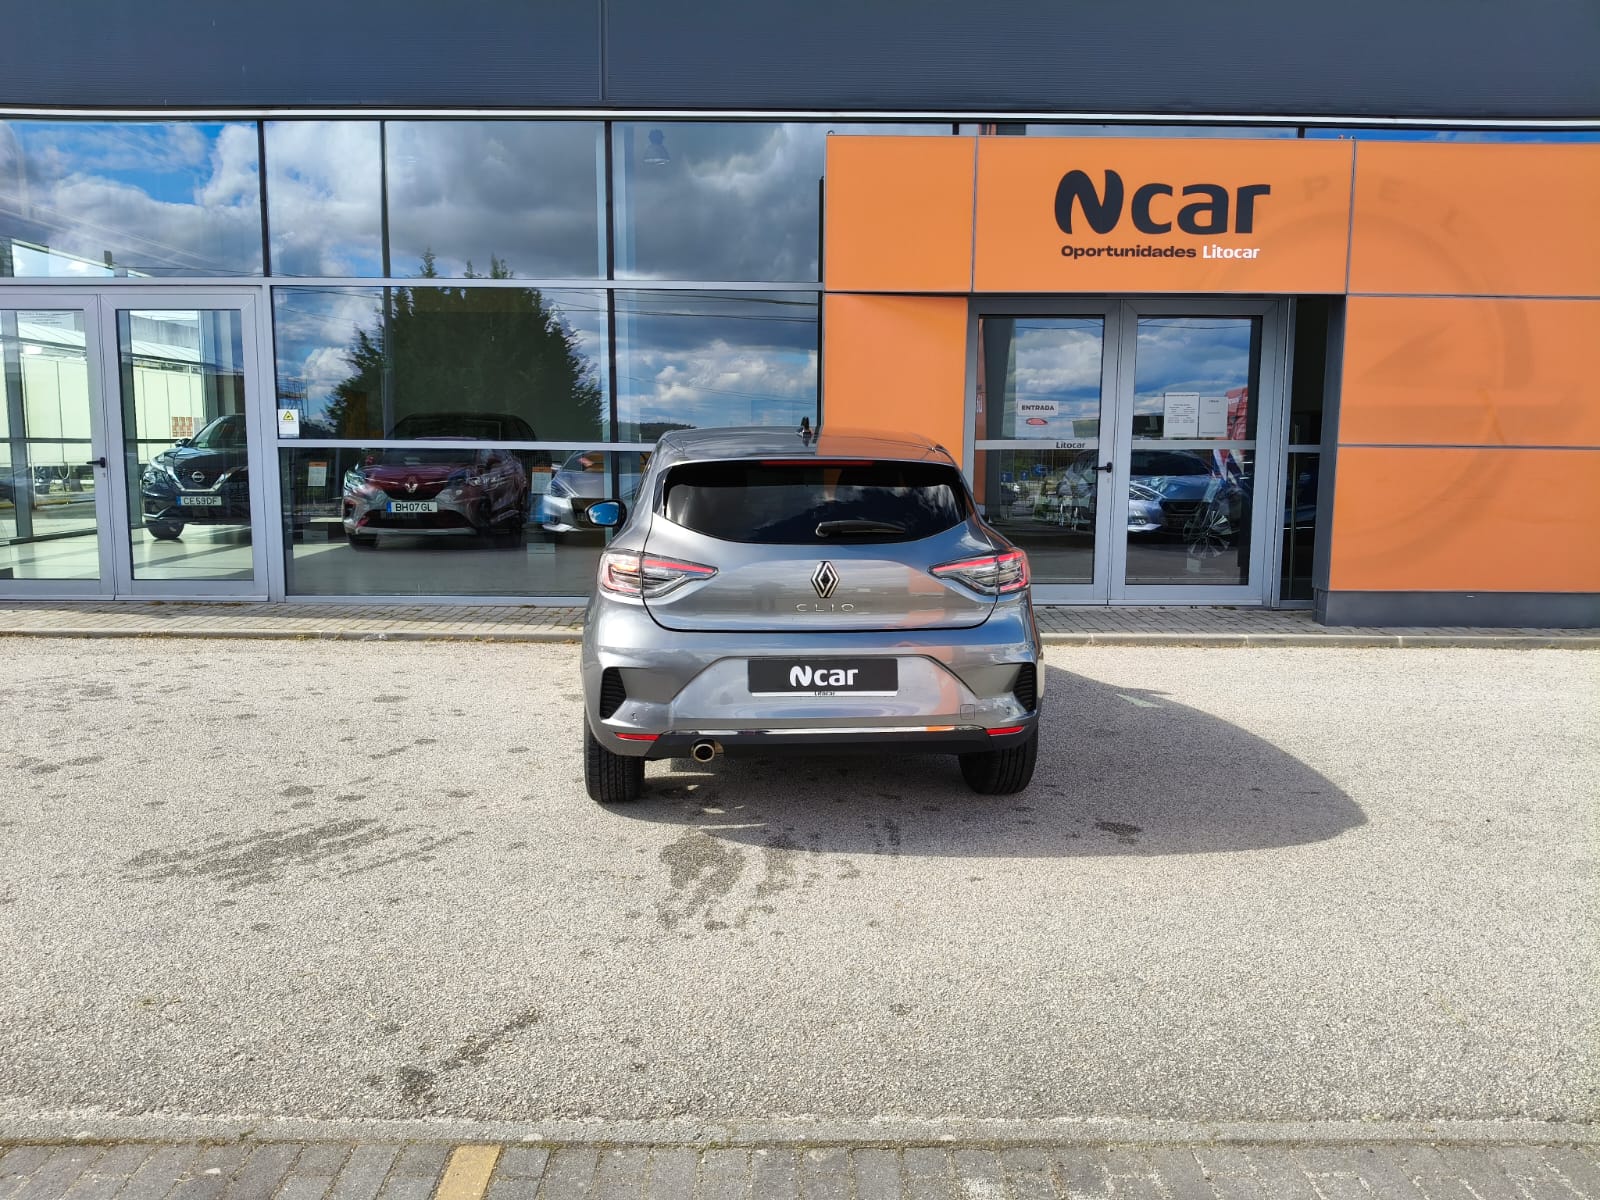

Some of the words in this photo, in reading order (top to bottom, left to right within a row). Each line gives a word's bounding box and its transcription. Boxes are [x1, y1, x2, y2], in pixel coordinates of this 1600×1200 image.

[1054, 169, 1271, 235] Ncar
[1061, 245, 1197, 260] Oportunidades
[1202, 244, 1261, 259] Litocar
[1055, 441, 1086, 449] Litocar
[795, 603, 855, 612] CLIO
[789, 665, 859, 687] Ncar
